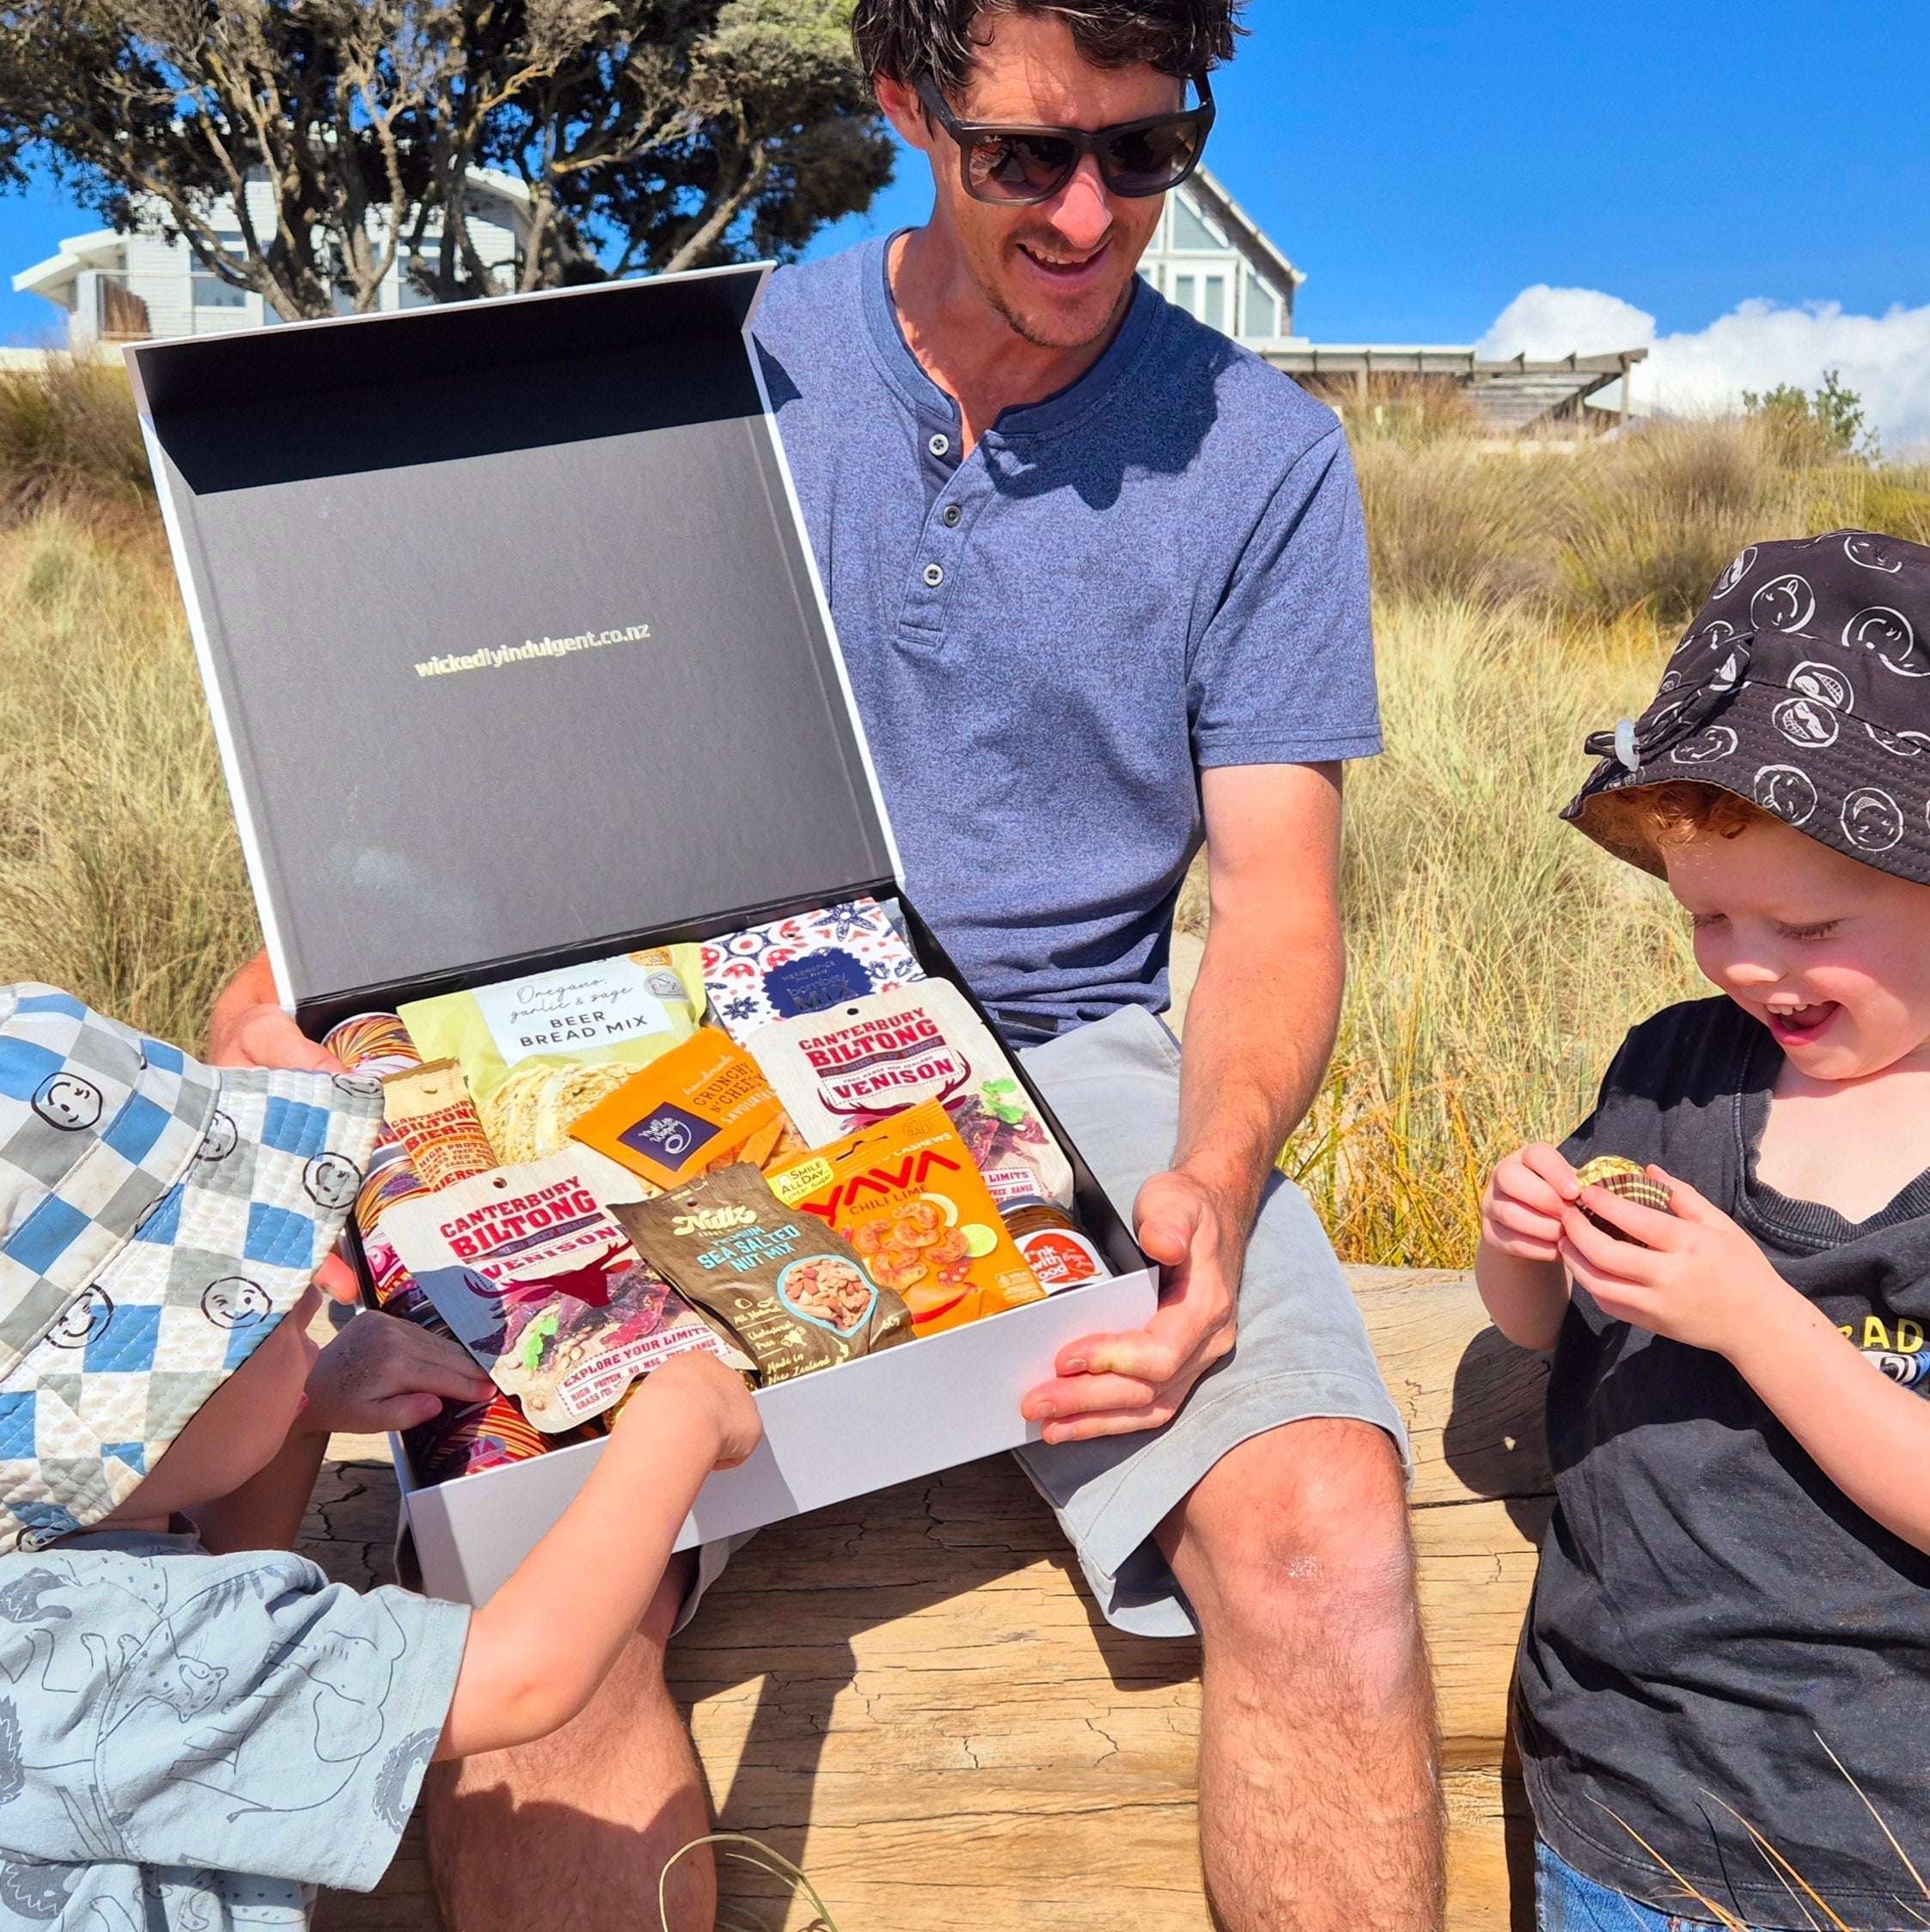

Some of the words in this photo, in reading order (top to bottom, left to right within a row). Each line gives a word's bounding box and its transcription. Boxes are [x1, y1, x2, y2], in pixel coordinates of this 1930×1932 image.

[414, 624, 650, 677] wickedlyindulgent.co.nz
[510, 999, 571, 1024] garlic
[572, 996, 583, 1006] &
[591, 987, 633, 1004] sage
[792, 979, 858, 1011] MIX
[520, 1027, 595, 1047] BREAD
[606, 1014, 648, 1035] MIX
[550, 1011, 607, 1029] BEER
[798, 1007, 925, 1050] CANTERBURY
[805, 1018, 939, 1067] BILTONG
[682, 1055, 735, 1096] handmade
[693, 1061, 754, 1106] CRUNCHY
[833, 1058, 956, 1099] VENISON
[391, 1100, 473, 1128] CANTERBUR
[418, 1146, 443, 1168] HIGH
[894, 1132, 953, 1156] CASHEWS
[790, 1160, 822, 1180] SMILE
[988, 1171, 1029, 1183] LIMITS
[799, 1150, 962, 1227] YAVA
[849, 1198, 889, 1214] CHILI
[895, 1184, 930, 1201] LIME
[439, 1175, 581, 1238] CANTERBURY
[672, 1205, 757, 1236] Nuttz
[448, 1189, 597, 1258] BILTONG
[480, 1226, 619, 1281] VENISON
[697, 1247, 738, 1270] SEA
[734, 1224, 802, 1254] SALTED
[730, 1253, 765, 1273] NUT
[763, 1242, 797, 1260] MIX
[1029, 1256, 1062, 1270] with
[1035, 1263, 1068, 1281] ood
[734, 1314, 748, 1324] All
[747, 1305, 782, 1321] Natural
[563, 1354, 620, 1388] EXPLORE
[623, 1339, 661, 1360] YOUR
[663, 1326, 710, 1346] LIMITS
[755, 1340, 777, 1350] Free
[767, 1358, 791, 1374] Made
[793, 1353, 804, 1362] in
[767, 1373, 789, 1385] New
[792, 1355, 832, 1378] Zealand
[571, 1385, 591, 1402] HIGH
[593, 1372, 623, 1390] PROTEIN
[628, 1365, 640, 1375] NO
[643, 1357, 661, 1369] MSG
[575, 1392, 600, 1410] GRASS
